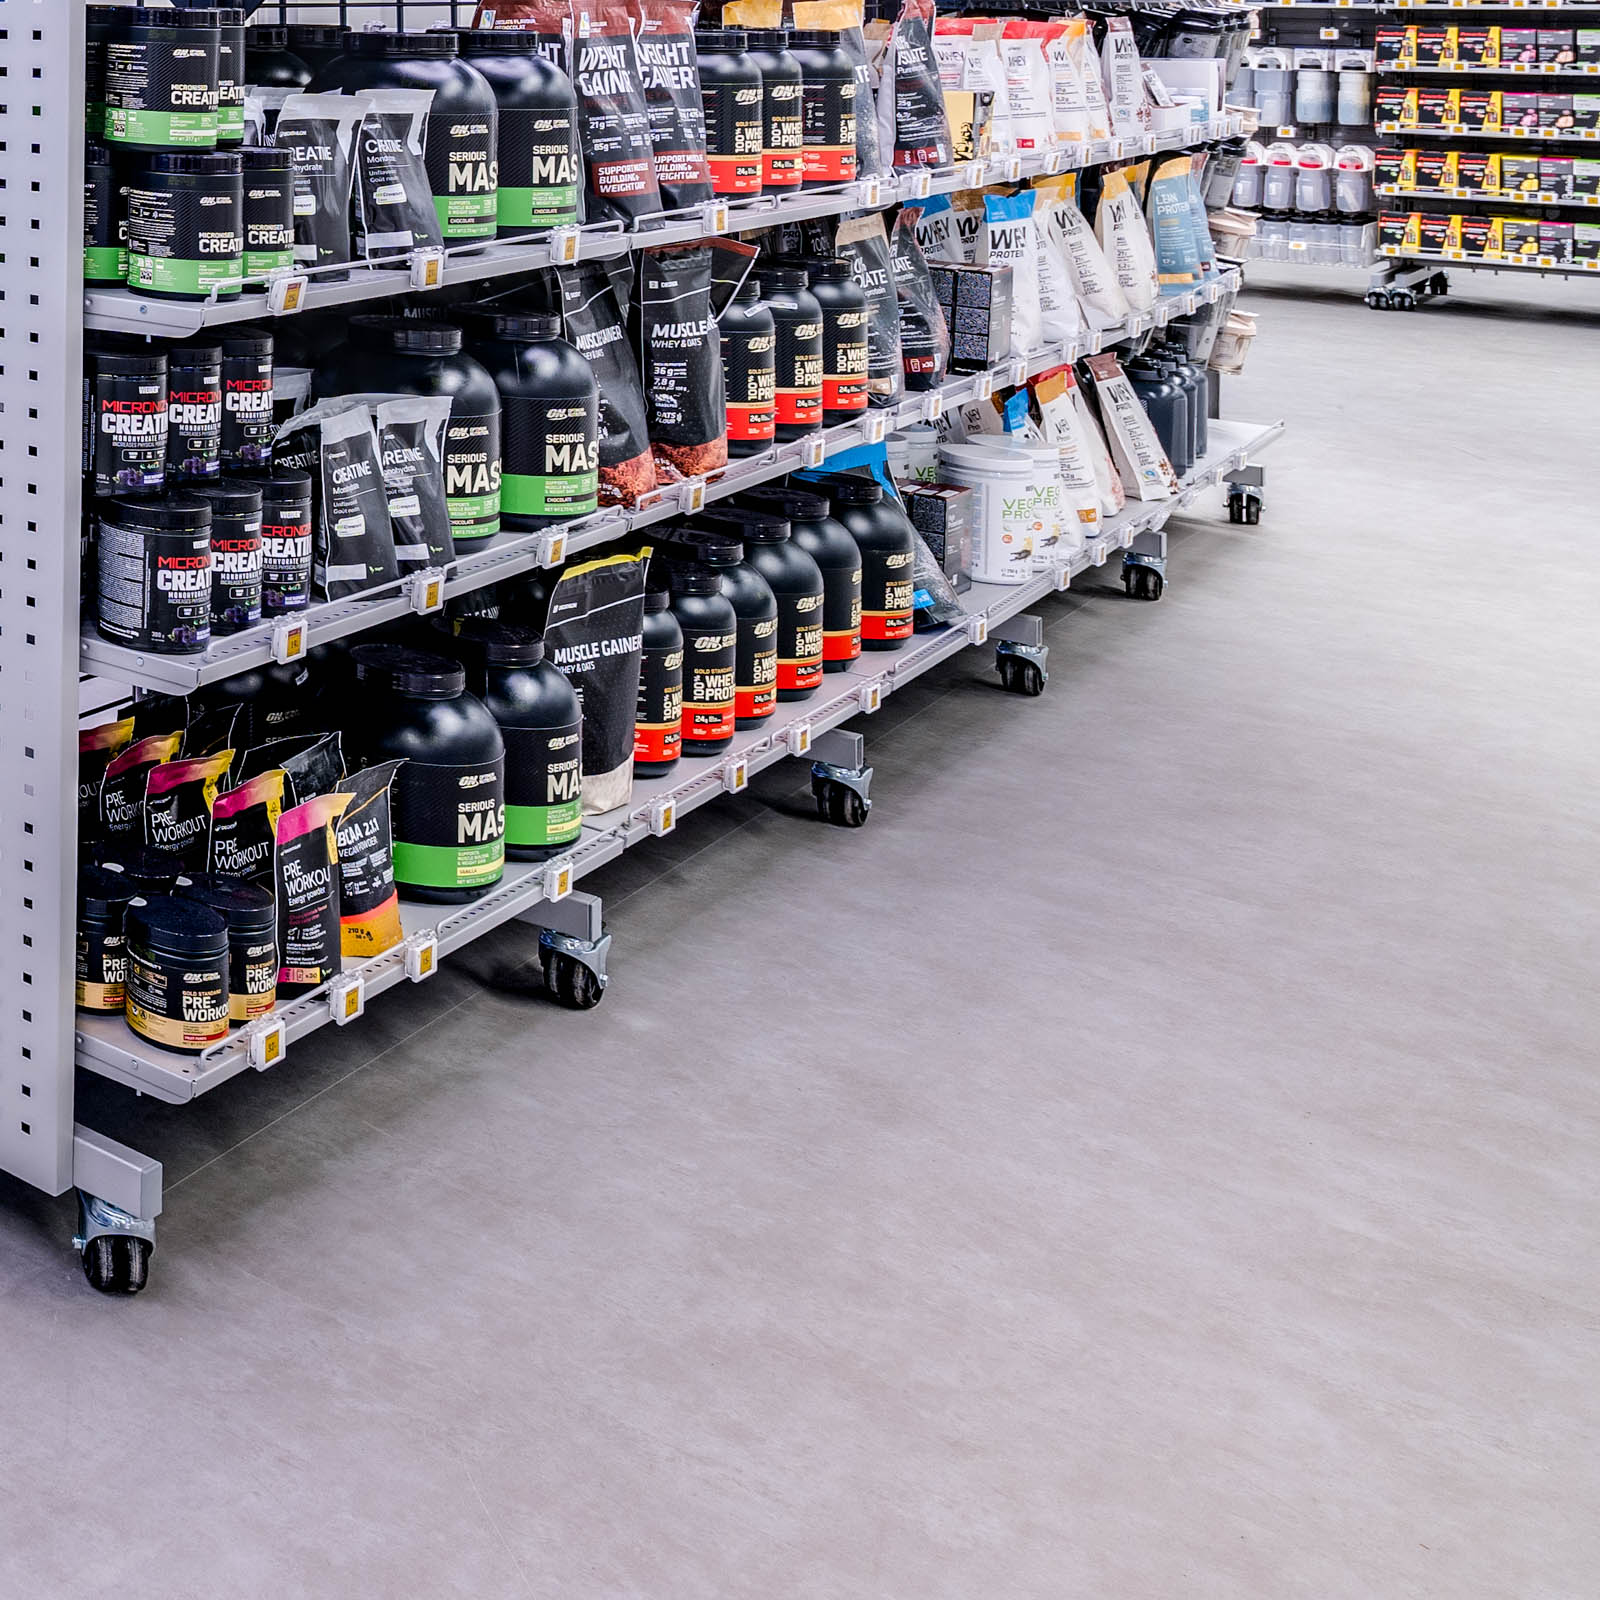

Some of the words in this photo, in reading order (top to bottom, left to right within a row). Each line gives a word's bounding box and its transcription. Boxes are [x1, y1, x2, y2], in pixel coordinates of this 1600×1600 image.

[448, 151, 486, 161] SERIOUS
[532, 145, 568, 155] SERIOUS
[652, 320, 708, 338] MUSCLE
[652, 340, 680, 348] WHEY
[546, 433, 585, 444] SERIOUS
[447, 452, 487, 464] SERIOUS
[554, 640, 600, 664] MUSCLE
[602, 634, 642, 656] GAINER
[694, 636, 722, 652] ON
[582, 661, 596, 672] OATS
[694, 676, 704, 700] 100%
[548, 758, 578, 773] SERIOUS
[106, 790, 126, 808] PRE
[458, 798, 496, 812] SERIOUS
[152, 810, 176, 827] PRE
[152, 815, 207, 842] WORKOUT
[215, 838, 238, 854] PRE
[215, 842, 270, 870] WORKOUT
[283, 860, 303, 880] PRE
[288, 895, 306, 906] Energy
[246, 966, 272, 980] PRE-
[182, 996, 216, 1010] PRE-
